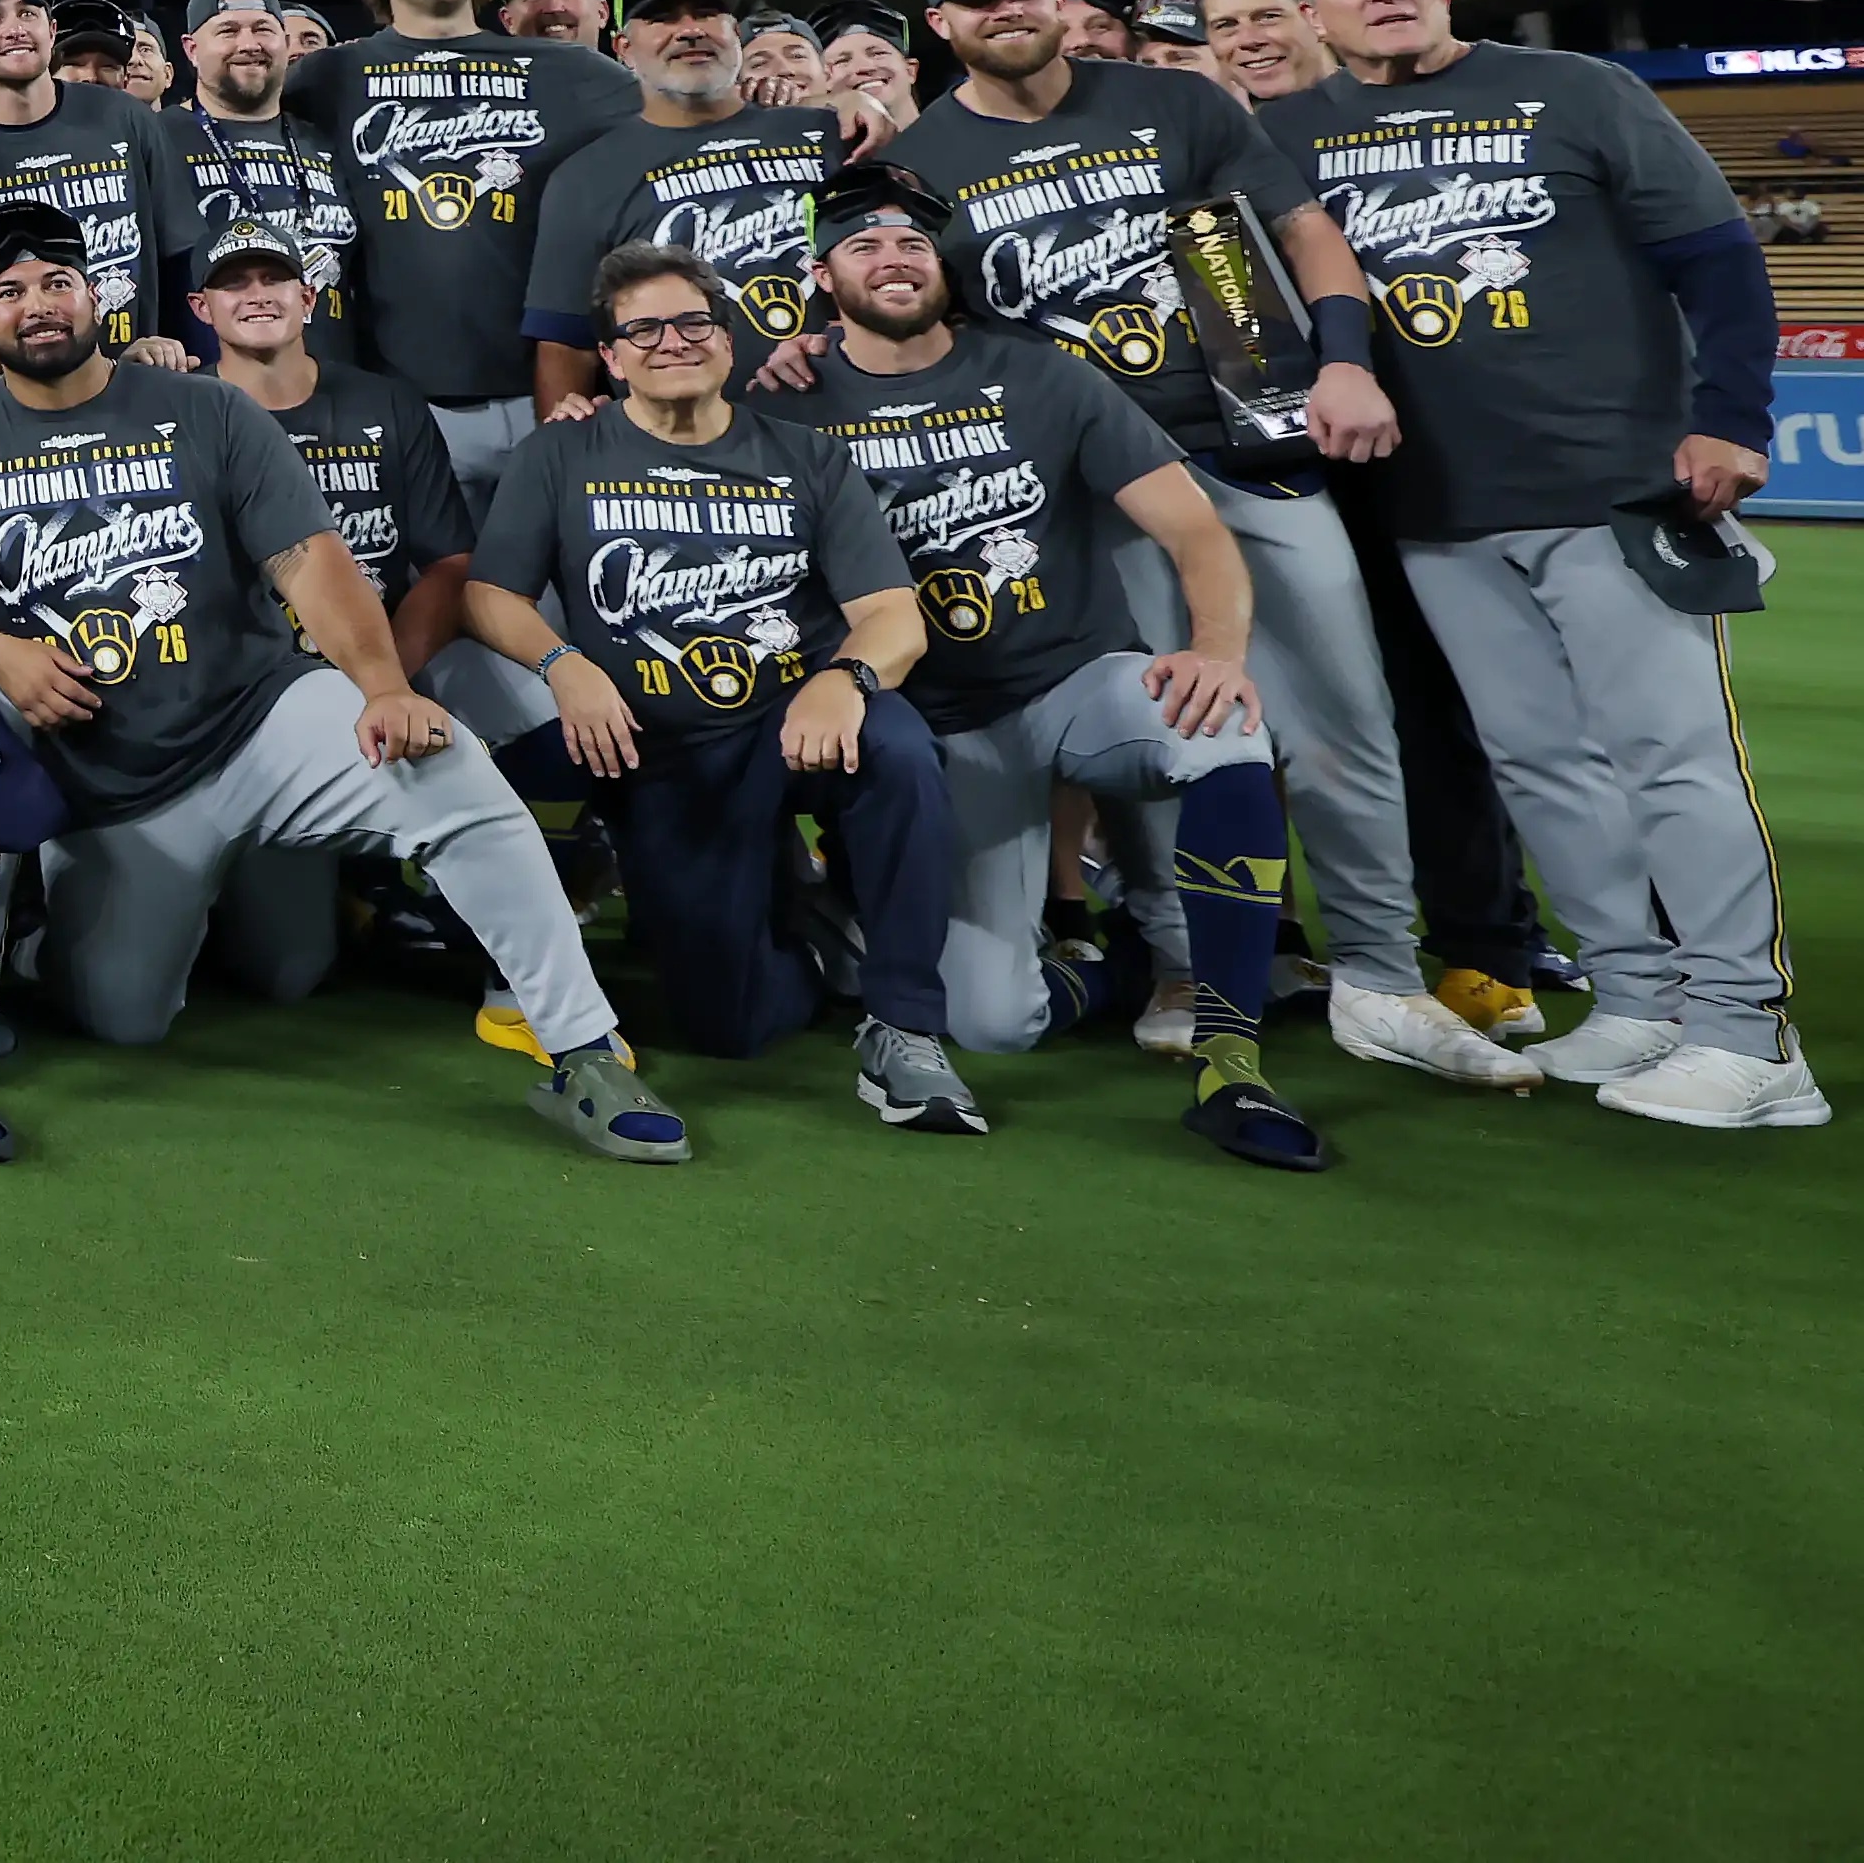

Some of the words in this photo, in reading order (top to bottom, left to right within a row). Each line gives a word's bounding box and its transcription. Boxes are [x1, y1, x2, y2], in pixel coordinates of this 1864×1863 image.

[1760, 49, 1845, 71] NLCS
[367, 74, 454, 99] NATIONAL
[461, 74, 529, 100] LEAGUE
[352, 100, 546, 166] Champions
[1317, 137, 1425, 181] NATIONAL
[1430, 134, 1531, 167] LEAGUE
[63, 174, 128, 206] LEAGUE
[652, 162, 753, 203] NATIONAL
[755, 158, 825, 187] LEAGUE
[966, 186, 1078, 234] NATIONAL
[1079, 163, 1166, 205] LEAGUE
[383, 189, 409, 223] 20
[491, 190, 515, 224] 26
[207, 240, 248, 263] WORLD
[249, 239, 290, 256] SERIES
[1195, 233, 1252, 329] NATIONAL
[108, 311, 132, 345] 26
[1487, 290, 1531, 329] 26
[92, 440, 174, 462] BREWERS
[929, 420, 1012, 464] LEAGUE
[96, 457, 174, 493] LEAGUE
[591, 499, 704, 535] NATIONAL
[708, 502, 796, 538] LEAGUE
[587, 537, 811, 629] Champions
[1009, 578, 1047, 616] 26
[157, 623, 188, 665] 26
[635, 659, 672, 698] 20
